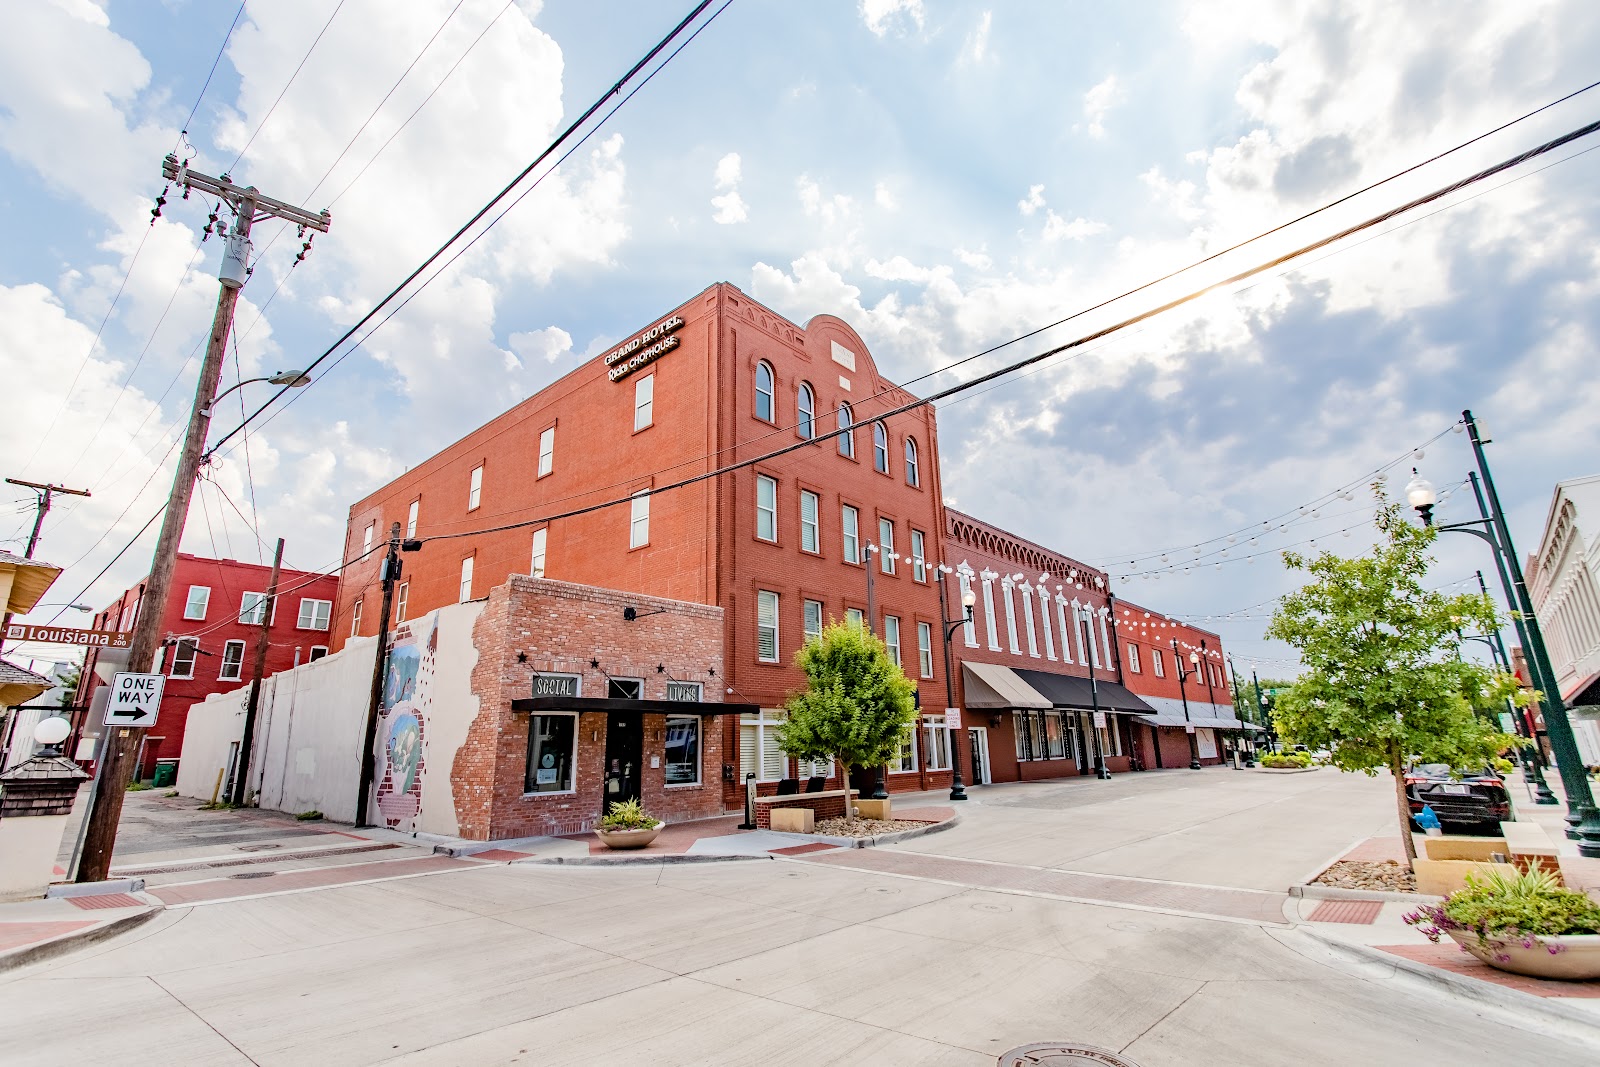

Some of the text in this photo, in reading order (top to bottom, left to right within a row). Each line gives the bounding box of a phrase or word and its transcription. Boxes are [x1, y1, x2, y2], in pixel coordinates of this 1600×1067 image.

[604, 315, 683, 365] GRAND HOTEL
[629, 335, 676, 368] CHOPHOUSE
[28, 627, 110, 645] Louisiana
[112, 639, 127, 647] 200
[122, 677, 156, 690] ONE
[537, 678, 572, 695] SOCIAL
[118, 691, 155, 704] WAY
[669, 687, 696, 701] LIVING
